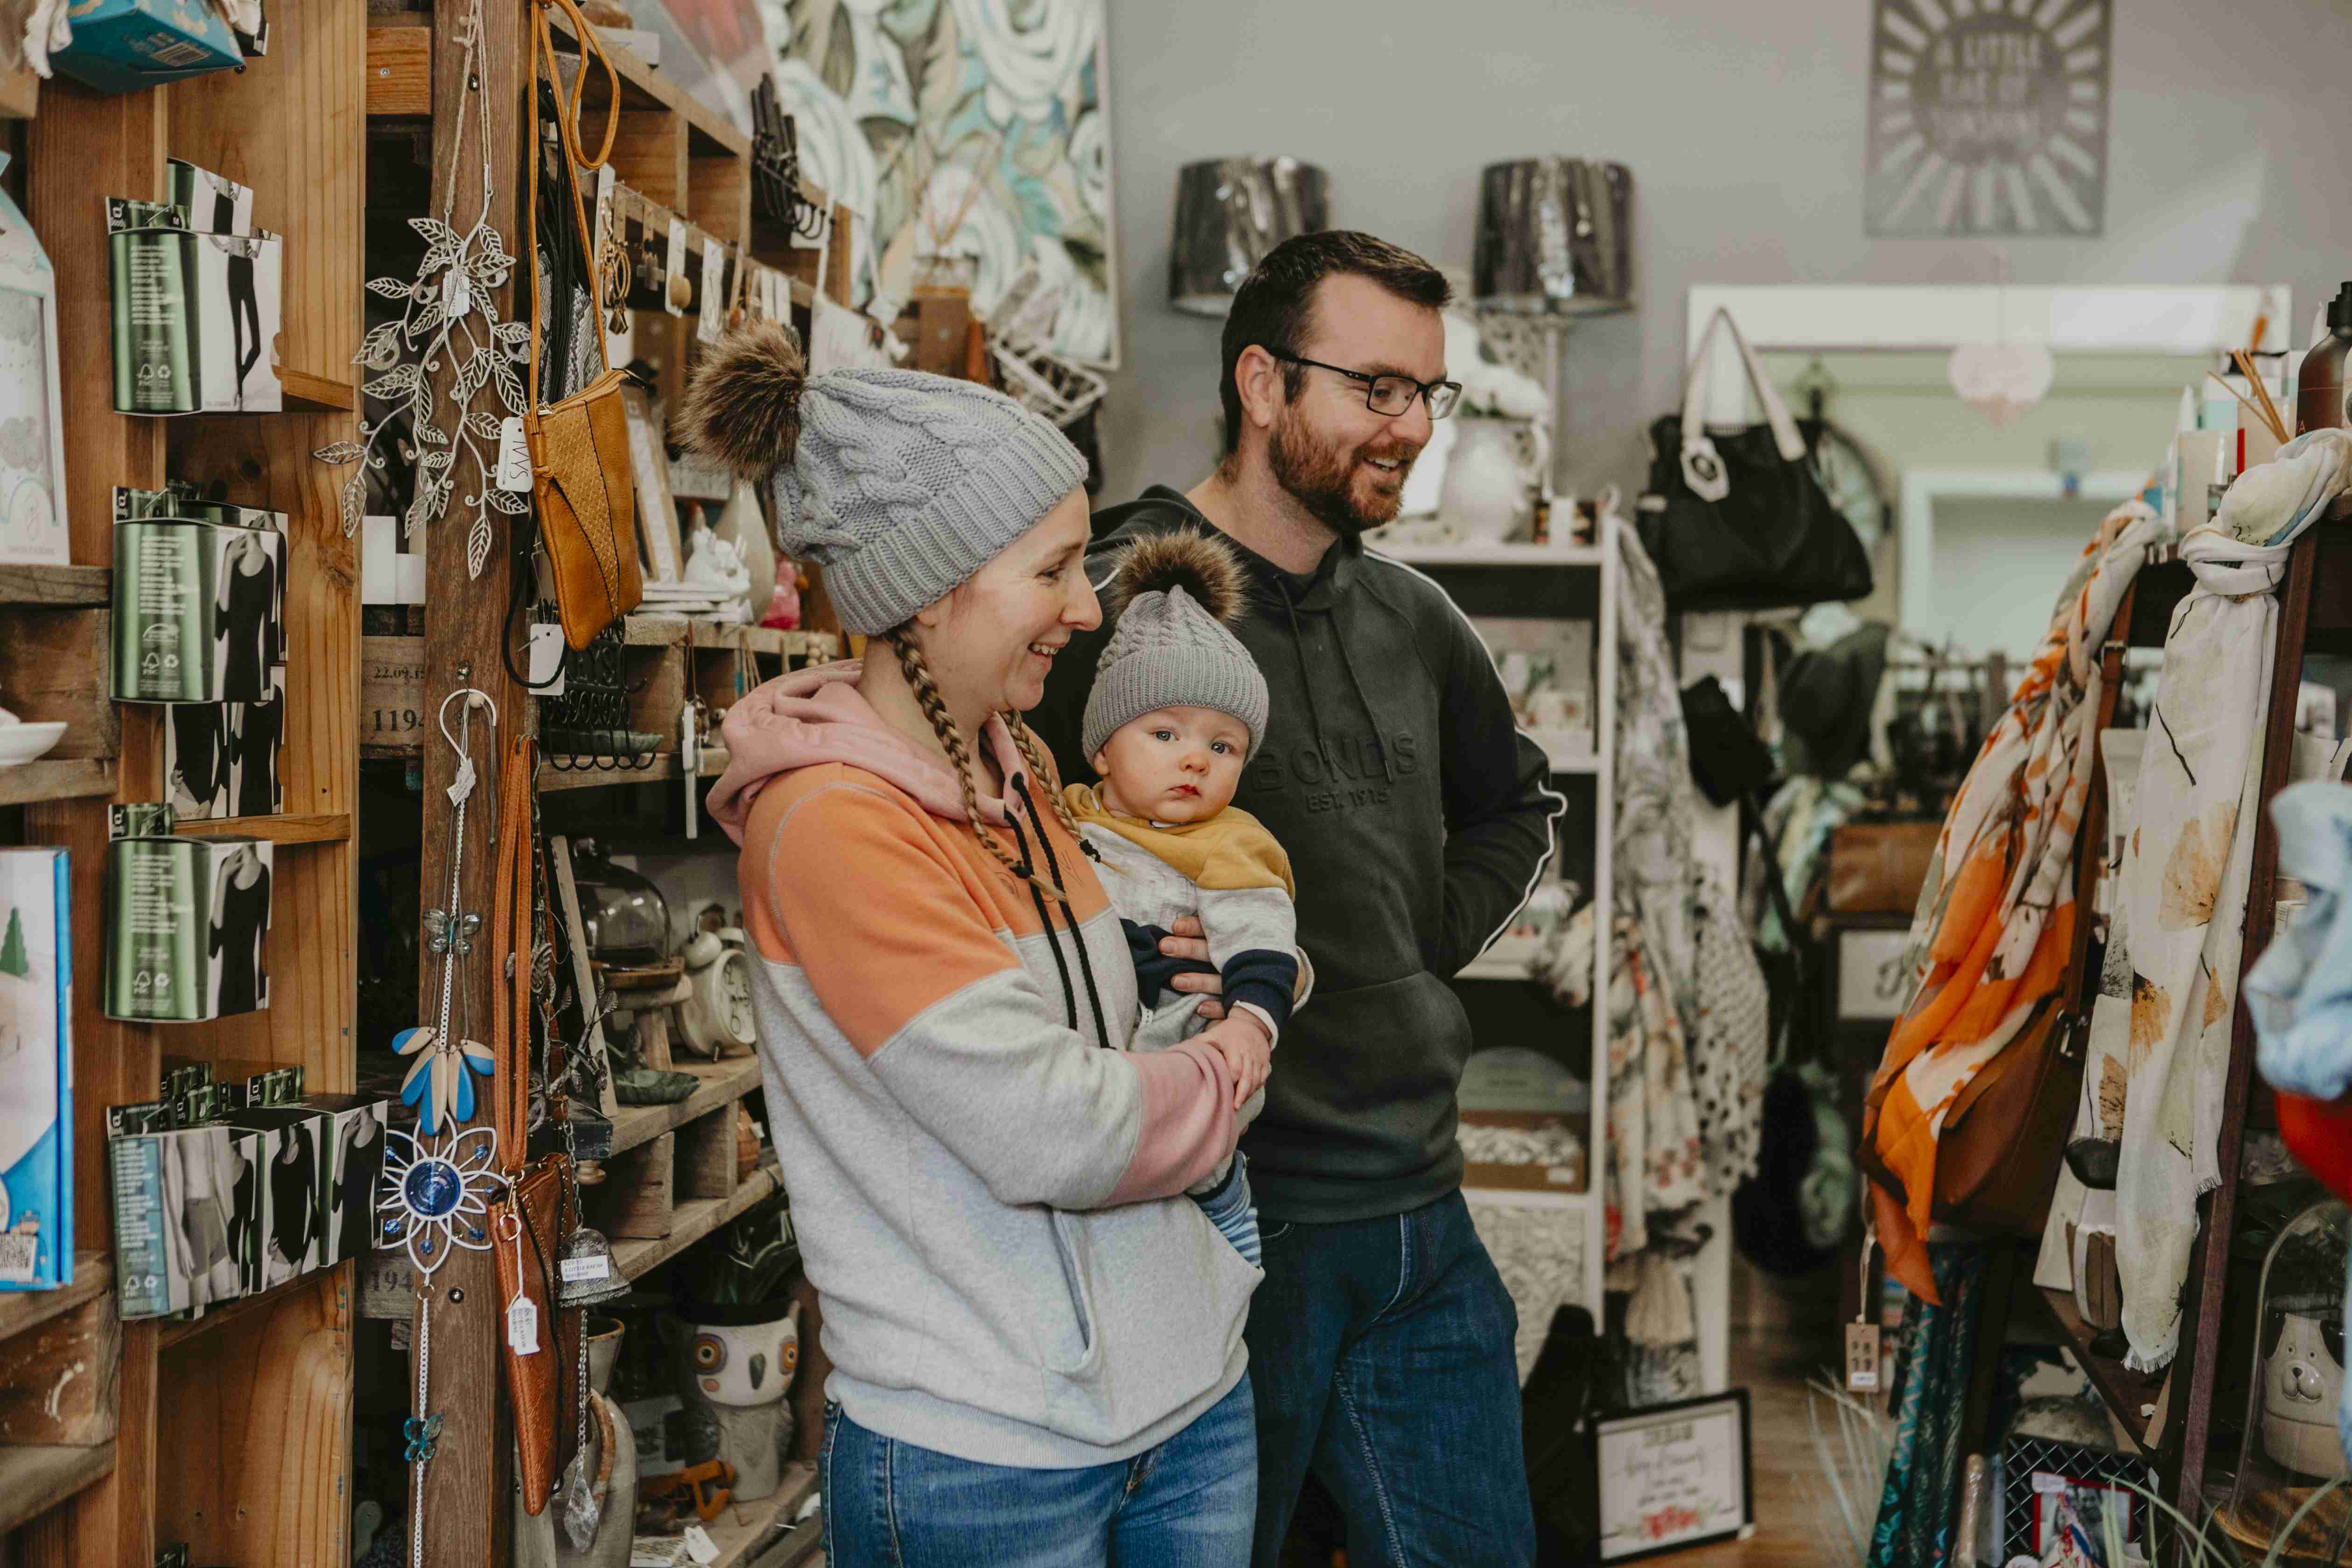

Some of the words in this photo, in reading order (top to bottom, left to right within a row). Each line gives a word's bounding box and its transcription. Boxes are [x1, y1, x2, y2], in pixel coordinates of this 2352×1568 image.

[1251, 731, 1418, 792] BONDS
[1305, 791, 1344, 812] EST.
[1348, 787, 1390, 807] 1915
